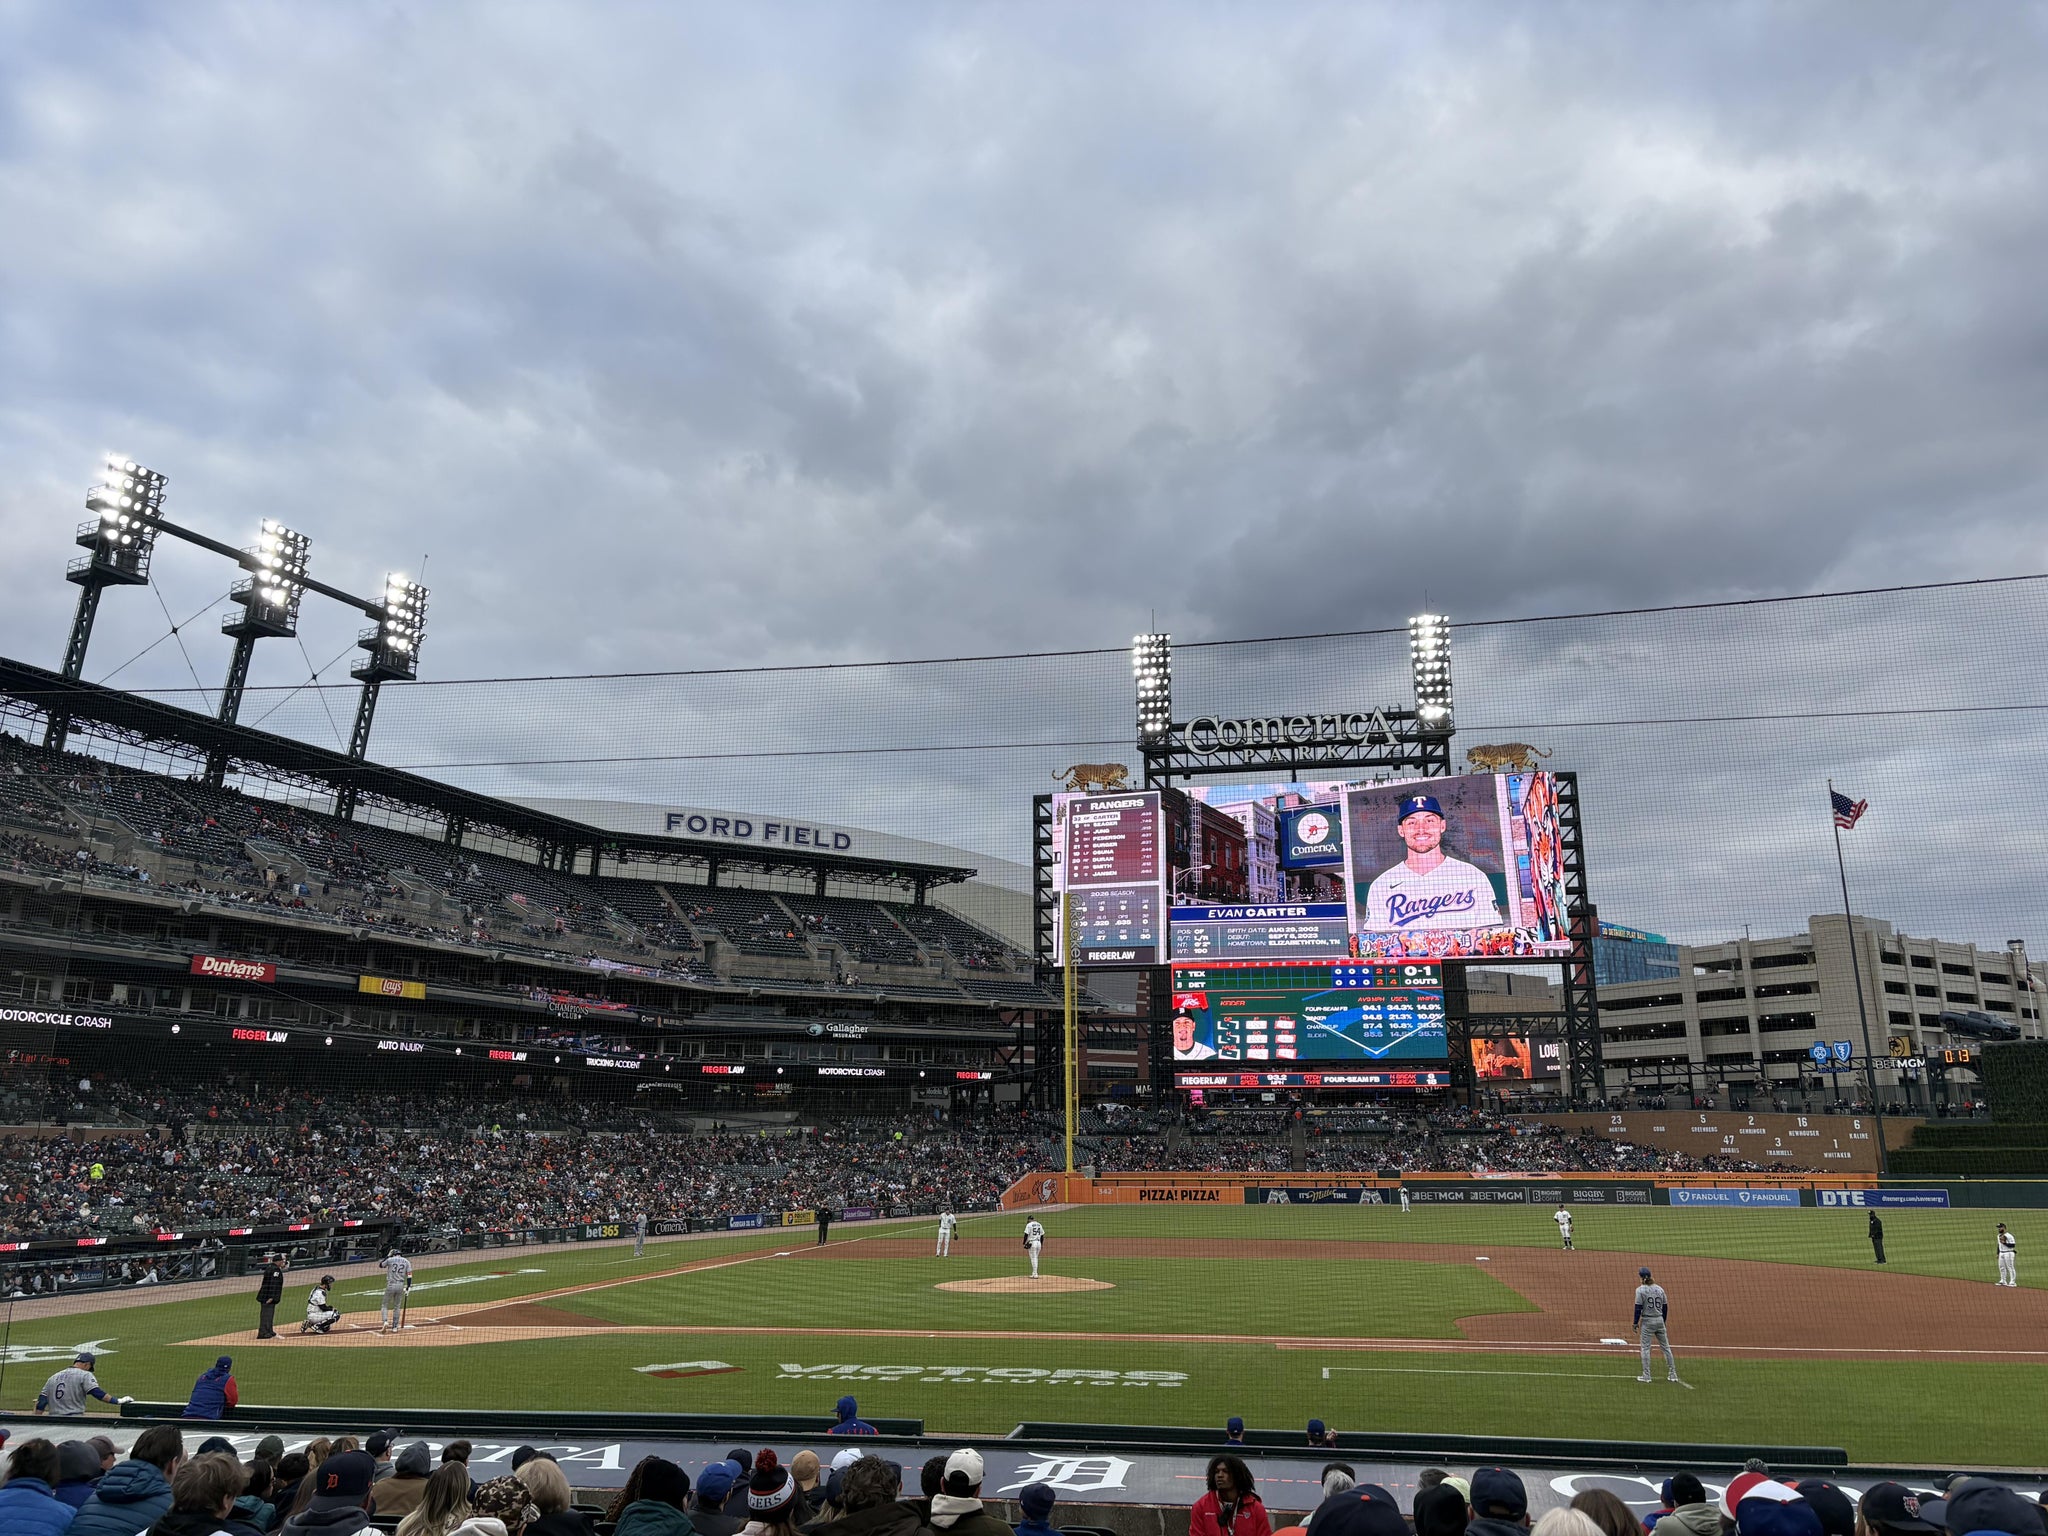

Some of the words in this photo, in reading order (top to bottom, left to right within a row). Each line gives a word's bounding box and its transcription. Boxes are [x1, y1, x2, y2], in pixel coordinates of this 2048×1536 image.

[1090, 799, 1145, 810] RANGERS
[666, 812, 753, 838] FORD
[764, 822, 851, 850] FIELD
[1092, 834, 1126, 842] PEDERSON
[1386, 889, 1475, 922] Rangers
[1208, 909, 1243, 918] EVAN
[1246, 907, 1306, 917] CARTER
[1637, 932, 1647, 940] BALL
[1088, 951, 1136, 961] FIEGERLAW
[202, 957, 266, 977] Dunham's
[1404, 966, 1431, 976] 0-1
[382, 980, 403, 994] Lay's
[549, 1002, 588, 1015] CHAMPIONS
[561, 1011, 578, 1020] CLUB
[74, 1016, 112, 1029] CRASH
[826, 1023, 869, 1034] Gallagher
[232, 1029, 288, 1043] FIEGERLAW
[377, 1040, 399, 1051] AUTO
[400, 1042, 425, 1052] INJURY
[489, 1049, 527, 1061] FIEGERLAW
[586, 1057, 614, 1068] TRUCKING
[615, 1059, 641, 1069] ACCIDENT
[1876, 1059, 1925, 1070] BETMGM
[702, 1065, 745, 1074] FIEGERLAW
[818, 1068, 863, 1076] MOTORCYCLE
[956, 1072, 992, 1080] FIEGERLAW
[1182, 1076, 1228, 1085] FIEGERLAW
[1611, 1116, 1622, 1124] 23
[1700, 1115, 1706, 1123] 5
[1748, 1116, 1754, 1125] 2
[1797, 1117, 1808, 1127] 16
[1854, 1120, 1860, 1130] 6
[1723, 1135, 1734, 1144] 47
[1775, 1137, 1781, 1147] 3
[1834, 1139, 1838, 1149] 1
[1140, 1190, 1178, 1201] PIZZA!
[1180, 1190, 1220, 1201] PIZZA!
[1420, 1192, 1464, 1200] BETMGM
[1478, 1192, 1523, 1200] BETMGM
[1692, 1193, 1729, 1201] FANDUEL
[1822, 1191, 1866, 1206] DTE
[229, 1228, 253, 1236] FIEGERLAW
[586, 1224, 619, 1238] bet365
[1032, 1228, 1040, 1236] 54
[77, 1238, 107, 1246] FIEGERLAW
[157, 1233, 183, 1241] FIEGERLAW
[392, 1263, 405, 1273] 32
[1647, 1296, 1662, 1308] 96
[778, 1363, 1190, 1381] VICTORS
[919, 1377, 1183, 1386] SOLUTIONS
[55, 1382, 66, 1400] 6
